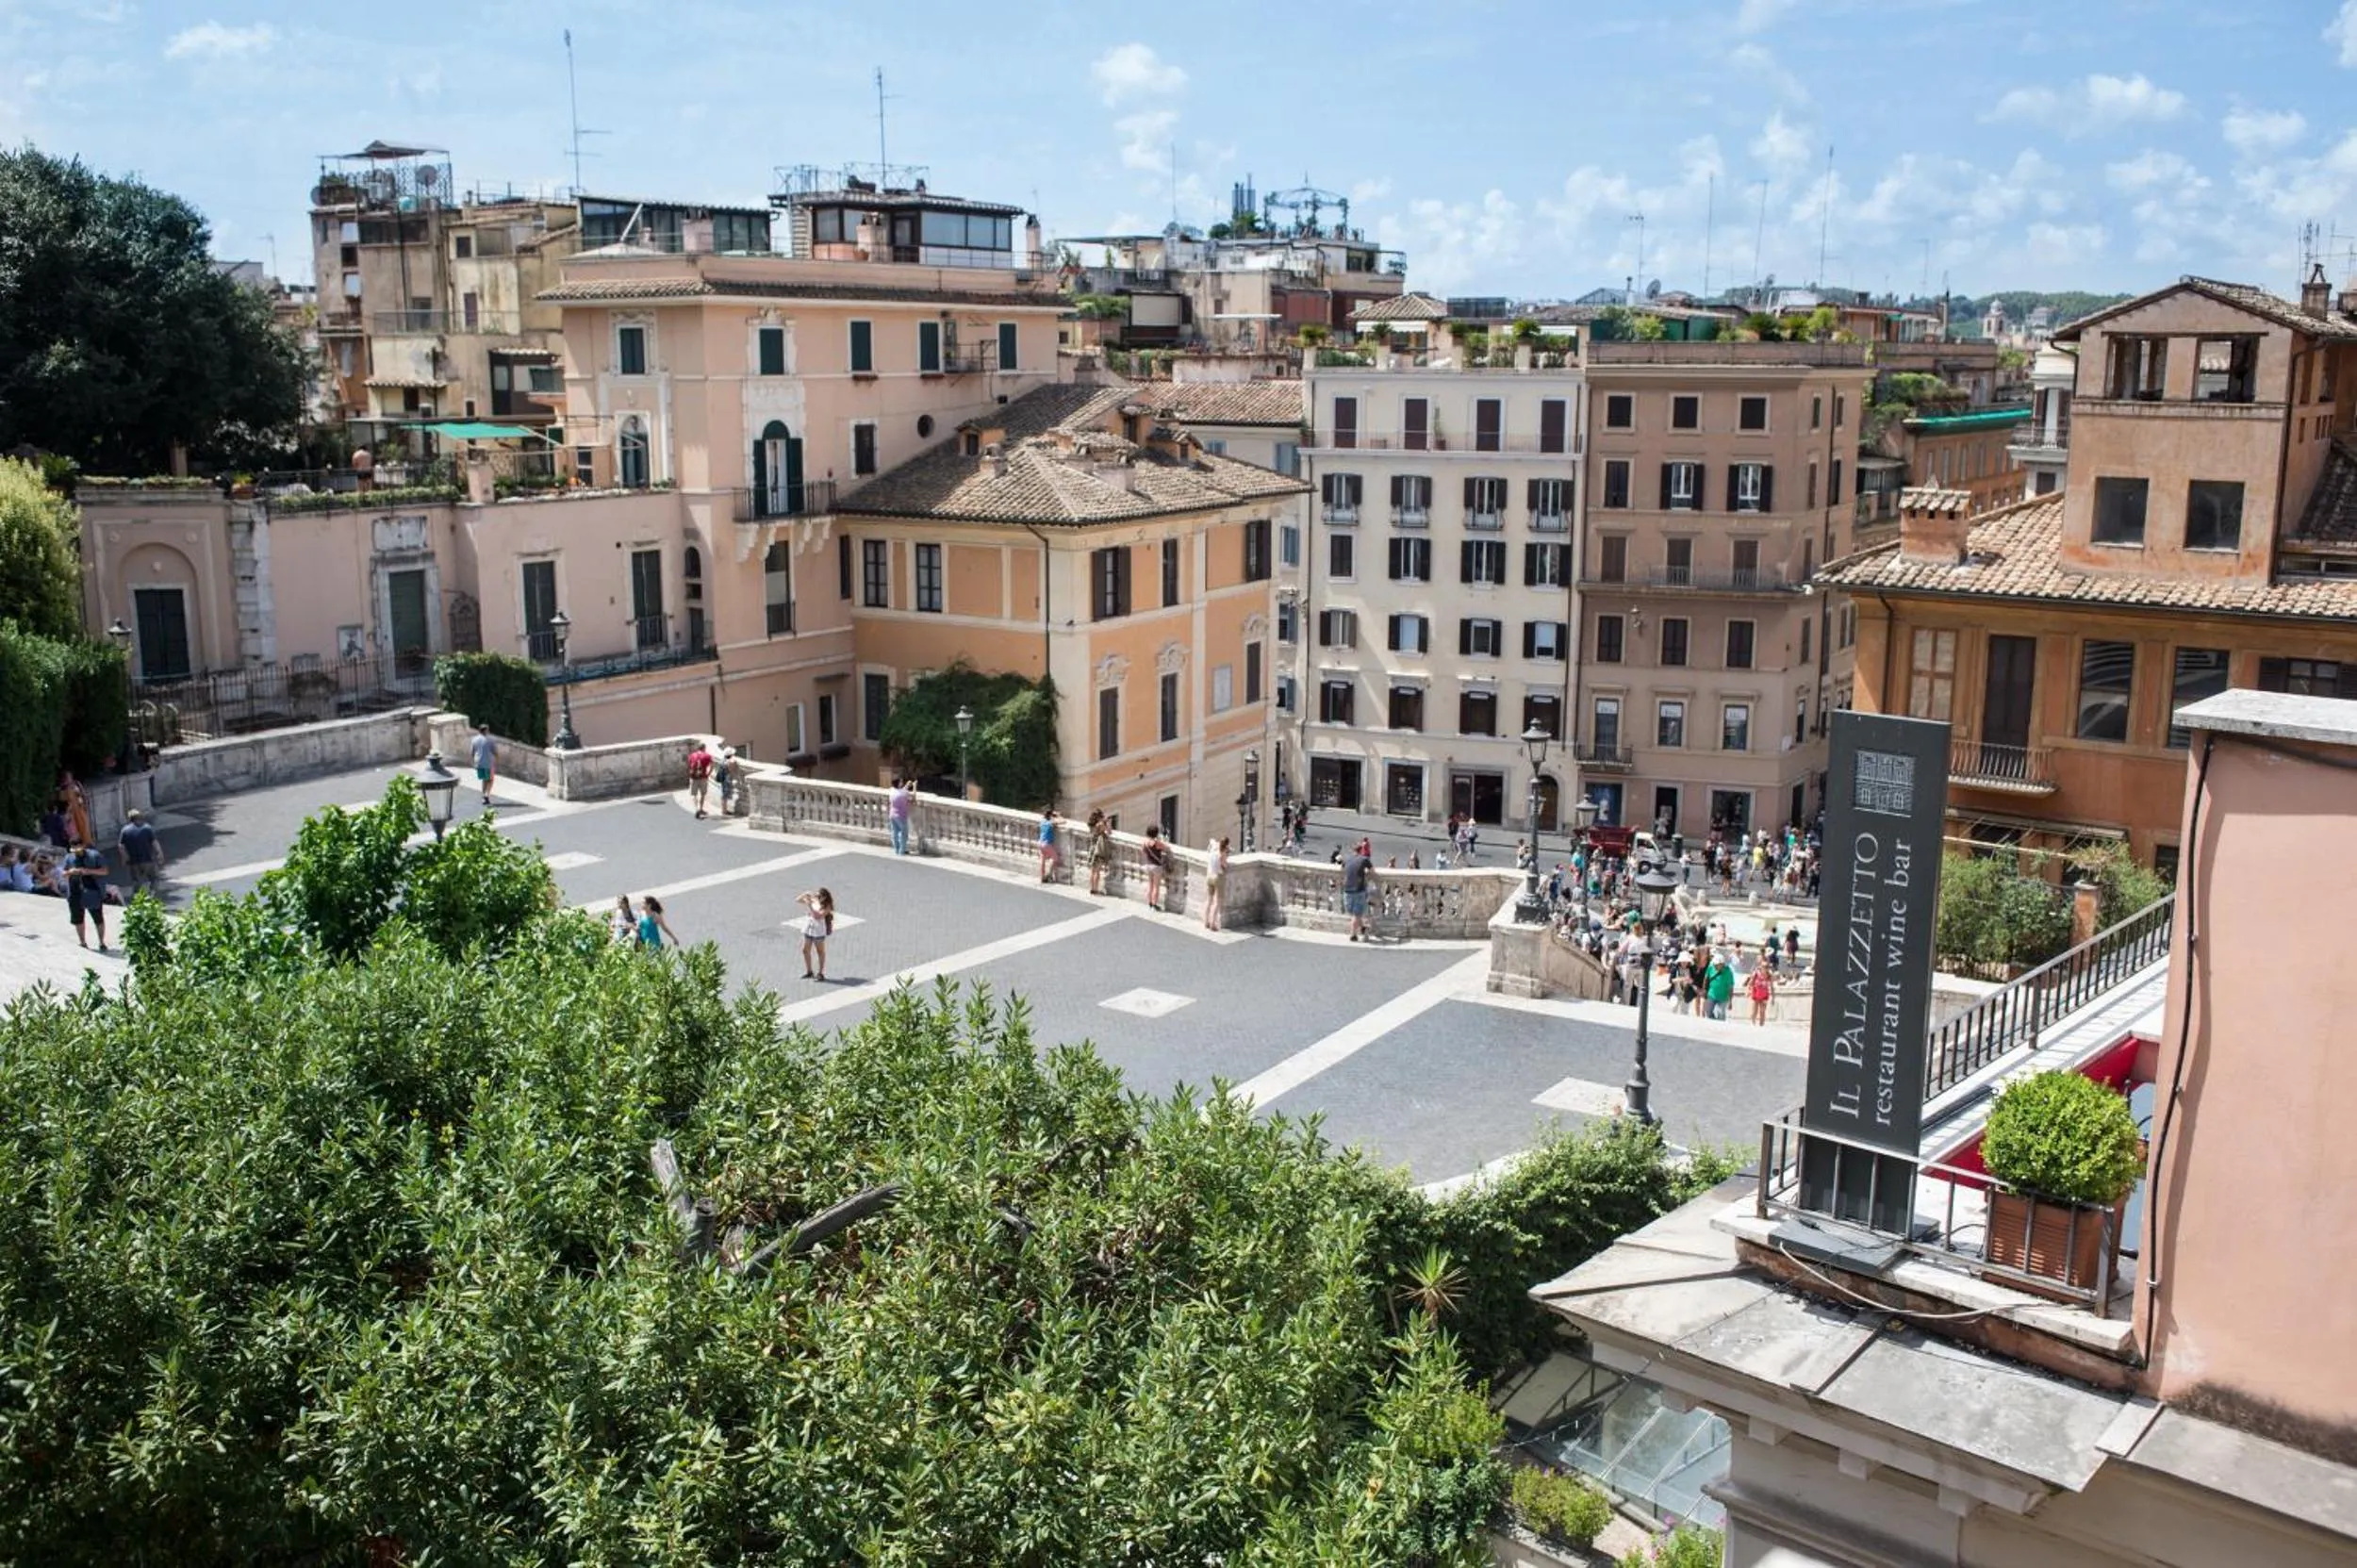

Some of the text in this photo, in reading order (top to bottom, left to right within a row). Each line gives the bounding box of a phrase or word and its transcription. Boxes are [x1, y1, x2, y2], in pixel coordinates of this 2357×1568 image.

[1829, 832, 1879, 1119] IL PALAZZETTO
[1875, 838, 1911, 1127] restaurant wine bar
